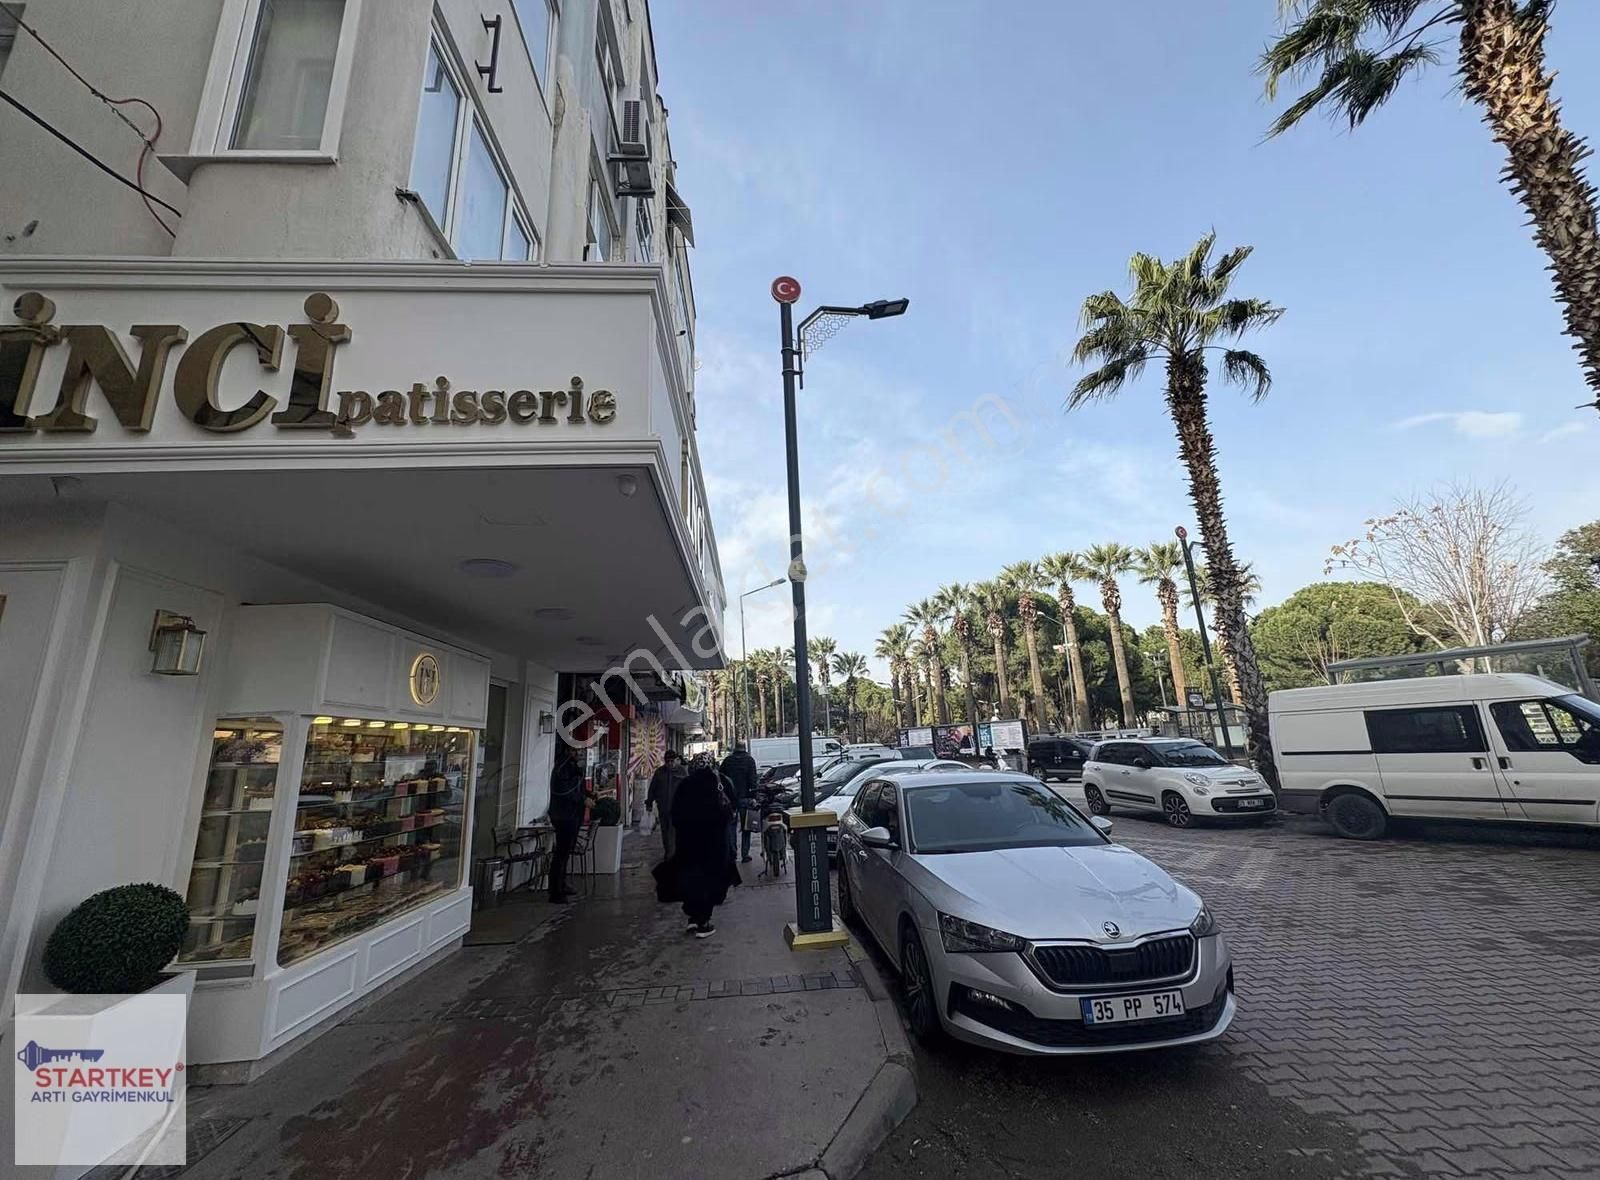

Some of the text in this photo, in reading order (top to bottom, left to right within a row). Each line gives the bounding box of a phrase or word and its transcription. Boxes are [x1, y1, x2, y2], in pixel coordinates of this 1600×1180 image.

[332, 376, 619, 437] patisserie
[1094, 1000, 1114, 1021] 35
[1123, 997, 1142, 1018] PP
[1153, 994, 1181, 1014] 574
